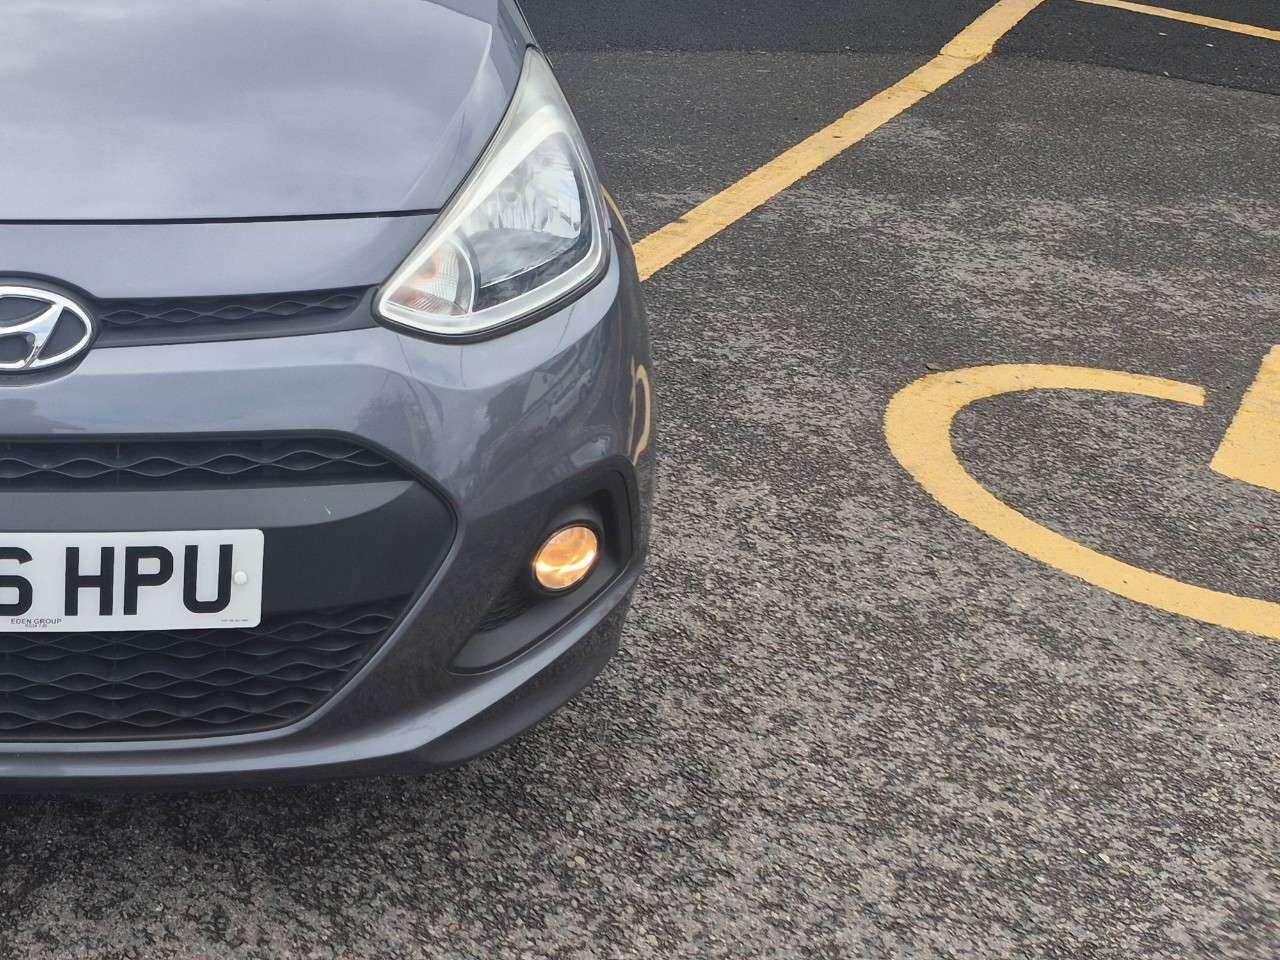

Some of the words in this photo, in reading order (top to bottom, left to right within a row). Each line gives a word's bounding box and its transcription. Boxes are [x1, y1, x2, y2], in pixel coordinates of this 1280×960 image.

[65, 544, 233, 615] HPU
[10, 617, 32, 625] EDEN
[33, 617, 62, 625] GROUP
